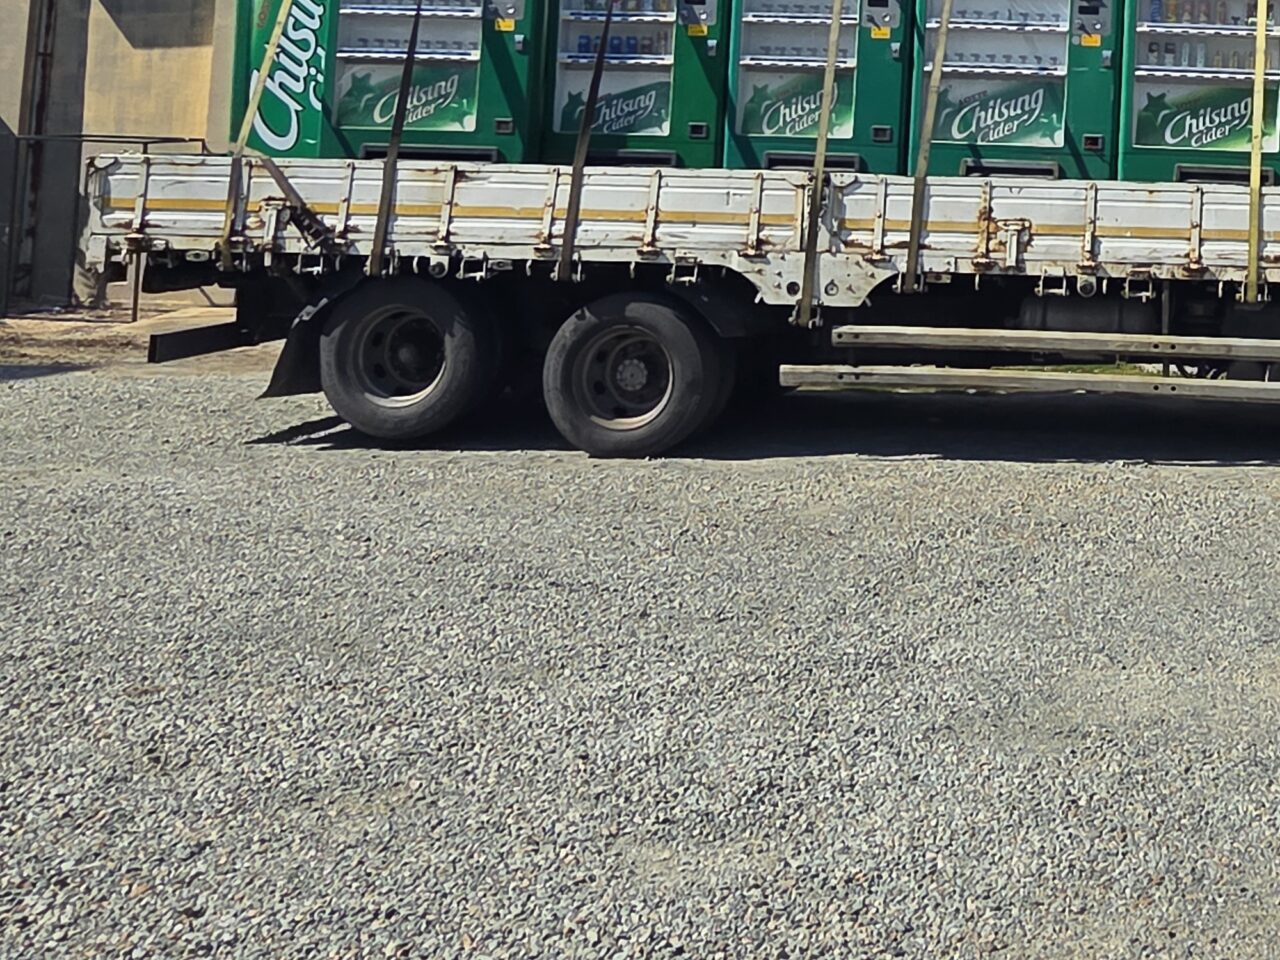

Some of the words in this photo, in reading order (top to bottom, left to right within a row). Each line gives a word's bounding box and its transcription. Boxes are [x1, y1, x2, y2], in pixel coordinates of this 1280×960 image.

[590, 90, 656, 129] hilsung
[951, 88, 1044, 139] Chilsung
[977, 114, 1029, 143] Cider
[1164, 97, 1252, 145] Chilsung
[1191, 119, 1240, 147] Cider
